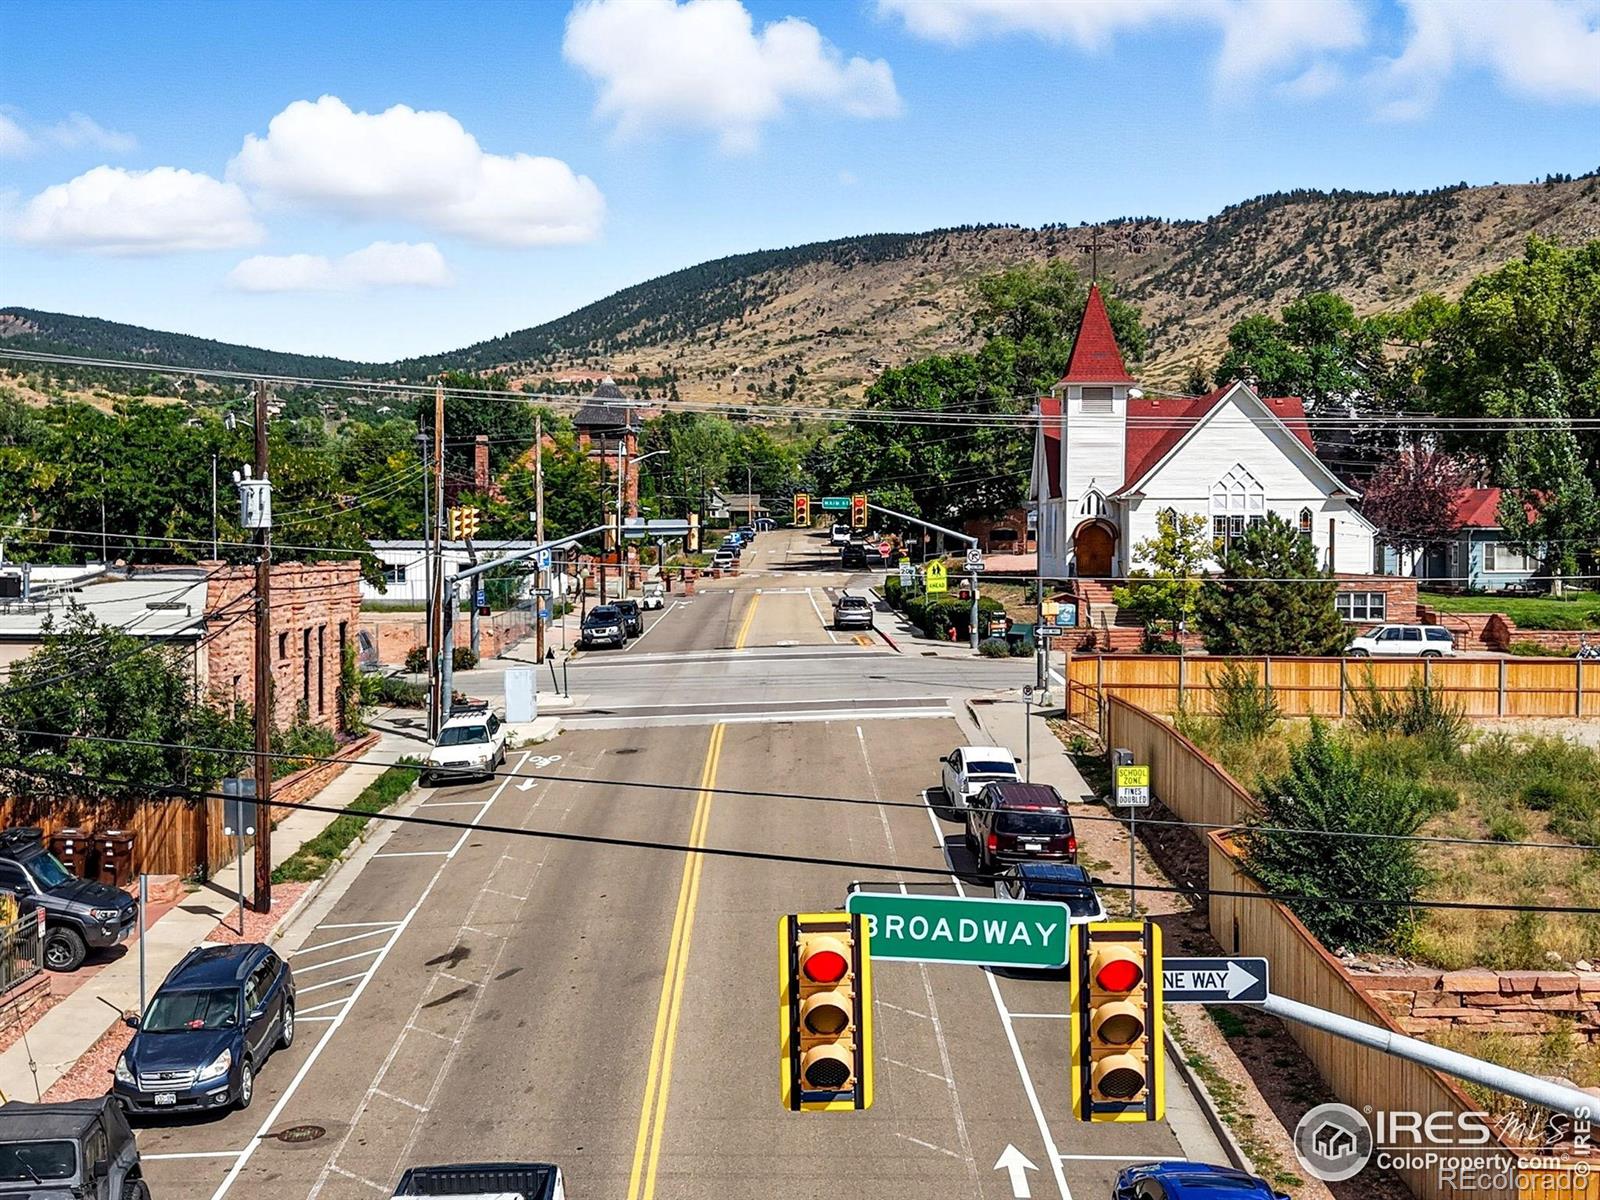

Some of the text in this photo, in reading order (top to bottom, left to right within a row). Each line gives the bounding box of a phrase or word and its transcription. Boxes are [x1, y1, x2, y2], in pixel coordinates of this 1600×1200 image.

[1119, 769, 1147, 777] SCHOOL
[1123, 777, 1142, 785] ZONE
[1124, 787, 1142, 795] FINES
[1119, 795, 1147, 804] DOUBLED
[1162, 972, 1228, 989] NE WAY
